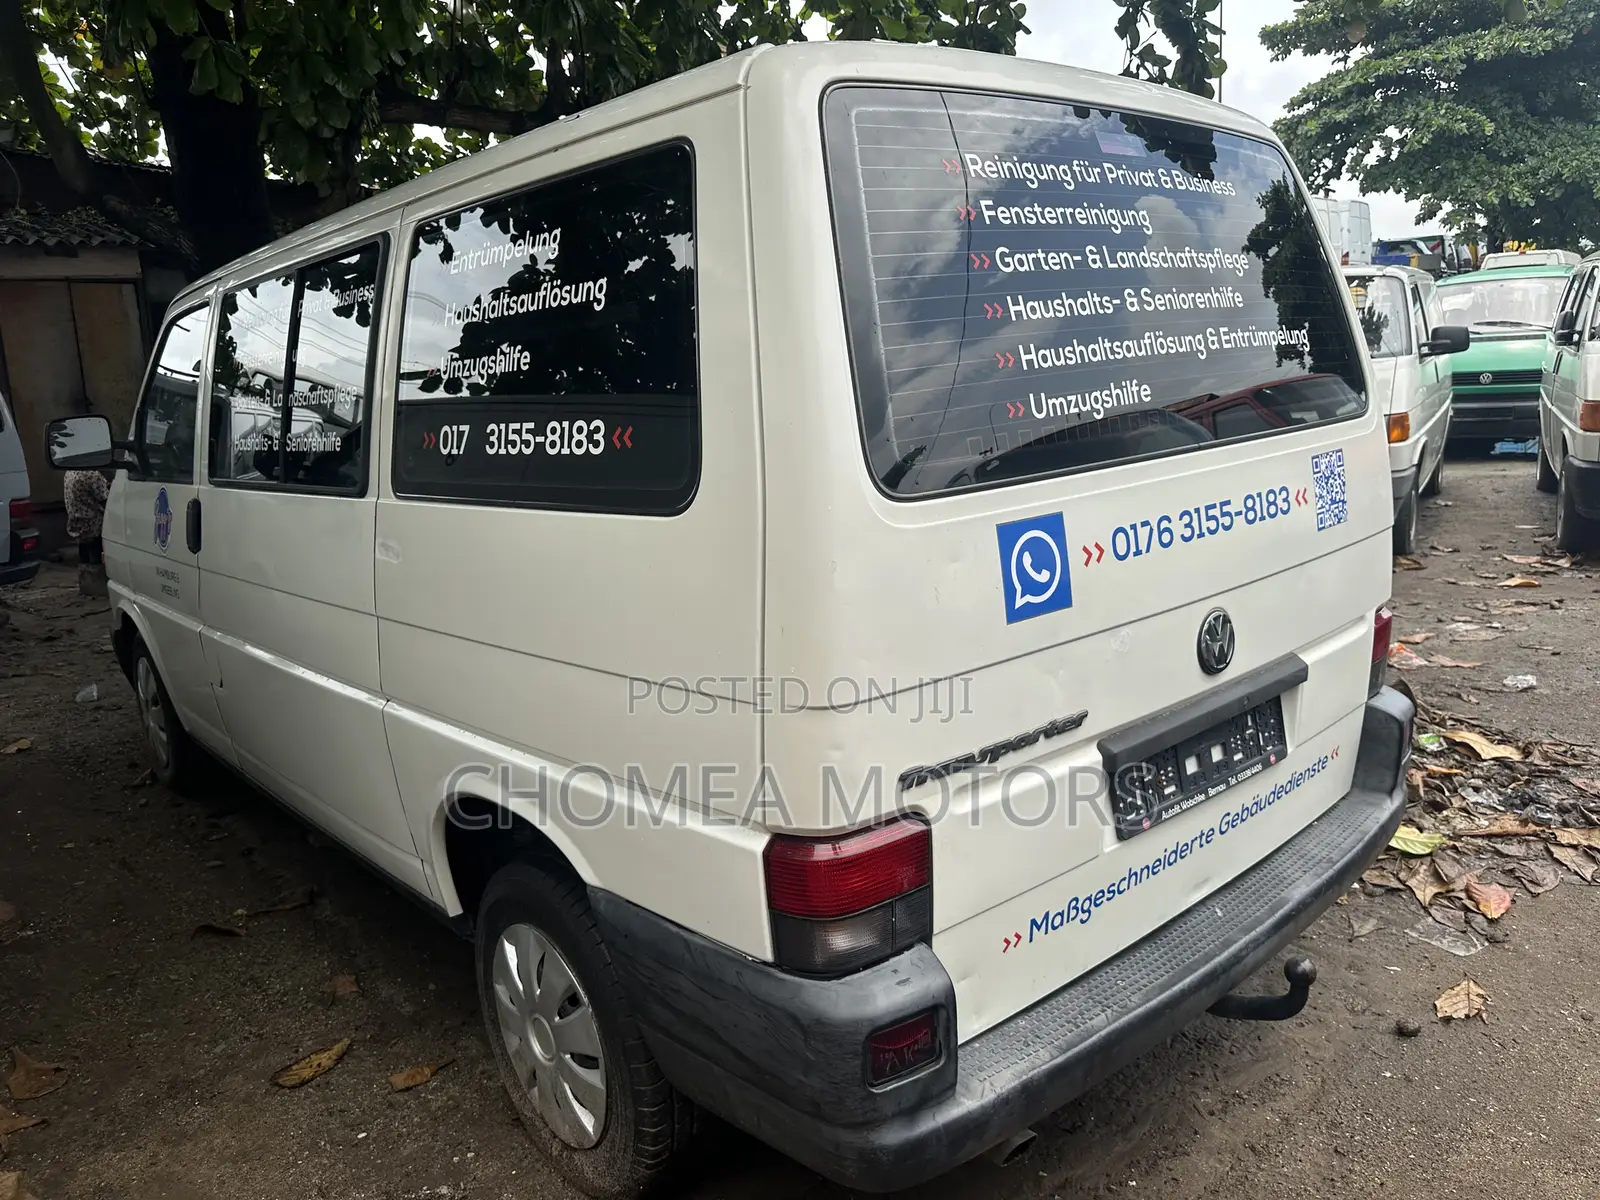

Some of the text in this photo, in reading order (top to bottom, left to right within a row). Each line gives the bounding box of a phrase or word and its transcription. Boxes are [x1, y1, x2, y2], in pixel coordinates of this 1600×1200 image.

[964, 153, 1236, 197] Reinigung für Privat & Business
[979, 199, 1153, 235] Fensterreinigung
[449, 226, 562, 275] Entrümpelung
[995, 245, 1249, 277] Garten- & Landschaftspflege
[444, 276, 607, 327] Haushaltsauflösung
[1006, 286, 1244, 321] Haushalts- & Seniorenhilfe
[440, 345, 530, 385] Umzugshilfe
[1018, 324, 1310, 370] Haushaltsauflösung & Entrümpelung
[1029, 379, 1152, 420] Umzugshilfe
[285, 431, 341, 453] Seniorenhilfe
[439, 419, 605, 456] 017 3155-8183
[1111, 485, 1291, 562] 0176 3155-8183
[1028, 751, 1329, 943] Maßgeschneiderte Gebäudedienste
